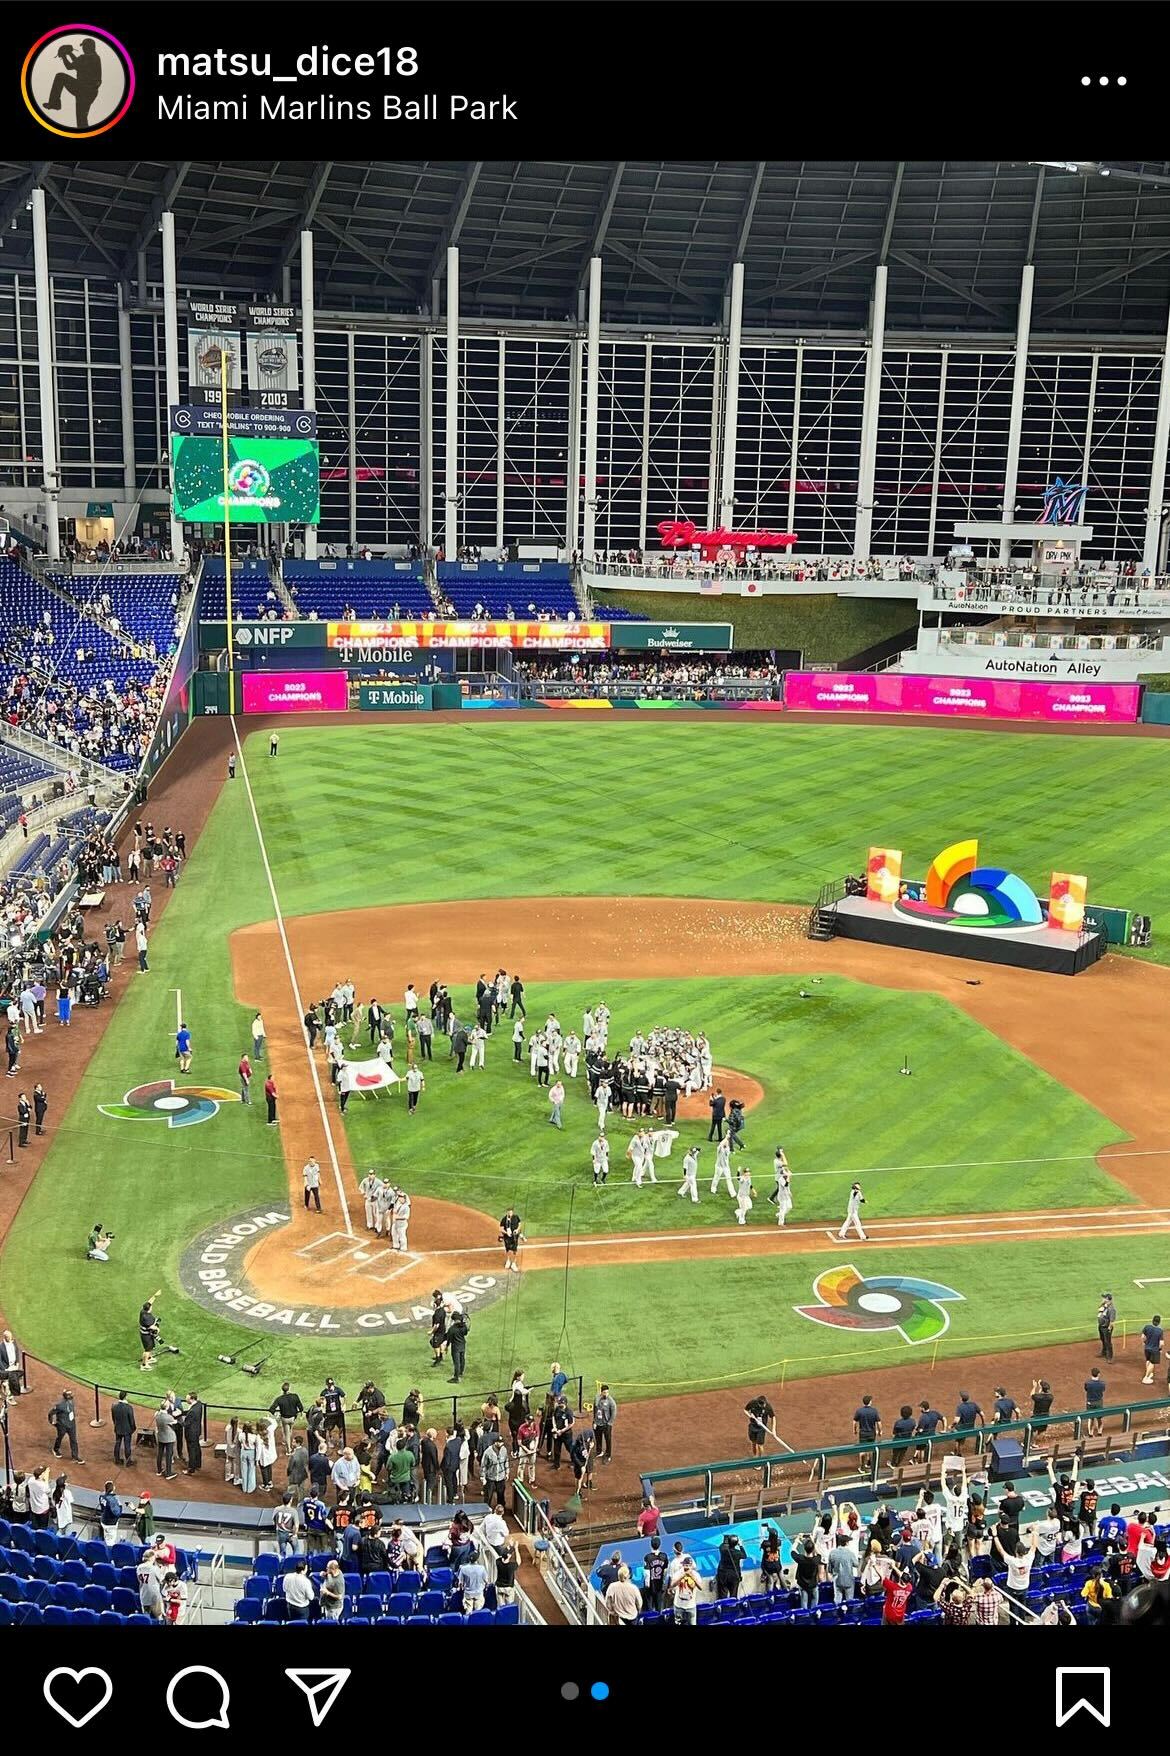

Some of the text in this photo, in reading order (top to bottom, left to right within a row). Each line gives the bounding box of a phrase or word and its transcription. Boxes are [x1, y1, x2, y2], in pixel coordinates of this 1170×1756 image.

[190, 302, 237, 315] WORLD SERIES
[248, 306, 294, 317] WORLD SERIES
[195, 312, 233, 324] CHAMPIONS
[253, 317, 290, 326] CHAMPIONS
[203, 390, 222, 403] 199
[260, 393, 288, 405] 2003
[250, 414, 285, 422] ORDERING
[197, 421, 215, 429] TEXT
[264, 424, 291, 432] 900-900
[948, 602, 988, 610] AutoNation
[1001, 606, 1041, 614] PROUD
[1047, 607, 1107, 616] PARTNERS
[254, 627, 293, 644] NFP
[333, 636, 418, 648] CHAMPIONS
[429, 636, 513, 648] CHAMPIONS
[523, 636, 606, 648] CHAMPIONS
[647, 638, 693, 648] Budweiser
[357, 647, 413, 663] Mobile
[984, 659, 1101, 677] AutoNation Alley
[268, 691, 322, 702] CHAMPIONS
[382, 690, 425, 705] Mobile
[816, 692, 869, 703] CHAMPIONS
[932, 696, 987, 708] CHAMPIONS
[1052, 703, 1106, 714] CHAMPIONS
[198, 1210, 498, 1330] WORLD BASEBALL CLASIC
[278, 1511, 292, 1524] 17
